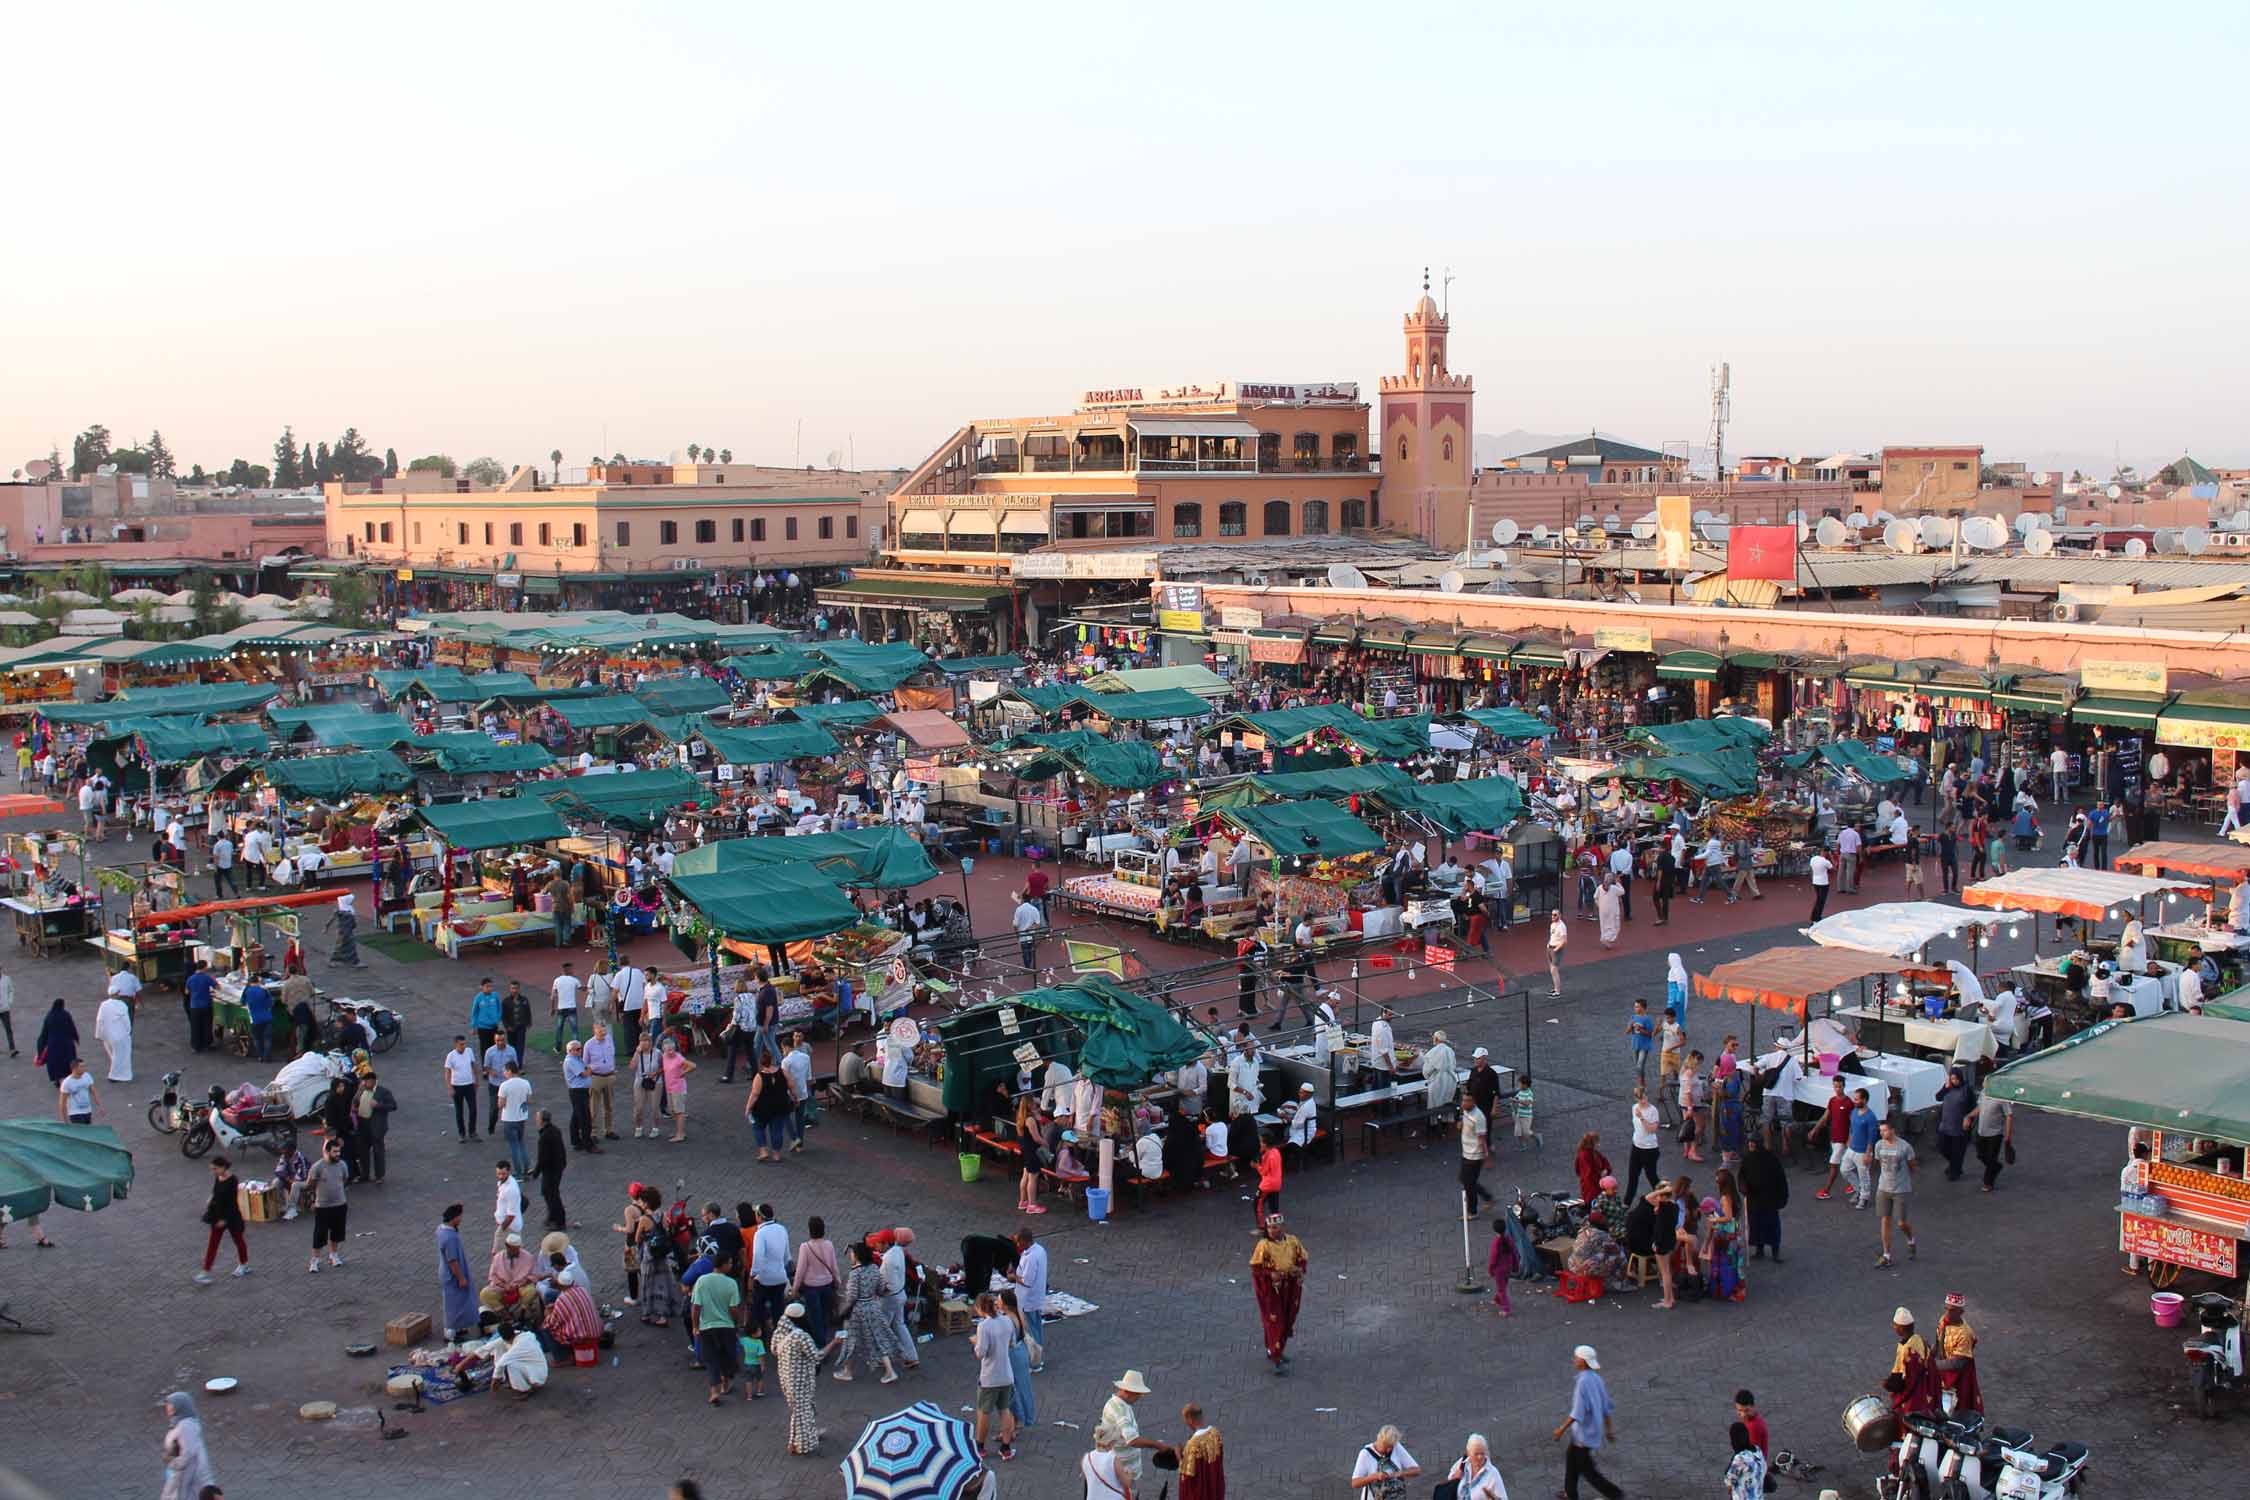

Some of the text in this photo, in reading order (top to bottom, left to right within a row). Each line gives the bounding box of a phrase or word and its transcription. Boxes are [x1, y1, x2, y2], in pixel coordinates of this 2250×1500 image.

[1085, 388, 1144, 403] ARGANA
[1241, 385, 1296, 399] ARGANA
[943, 495, 995, 506] RESTAURANT
[1003, 495, 1041, 506] GLACIER
[720, 768, 731, 777] 32
